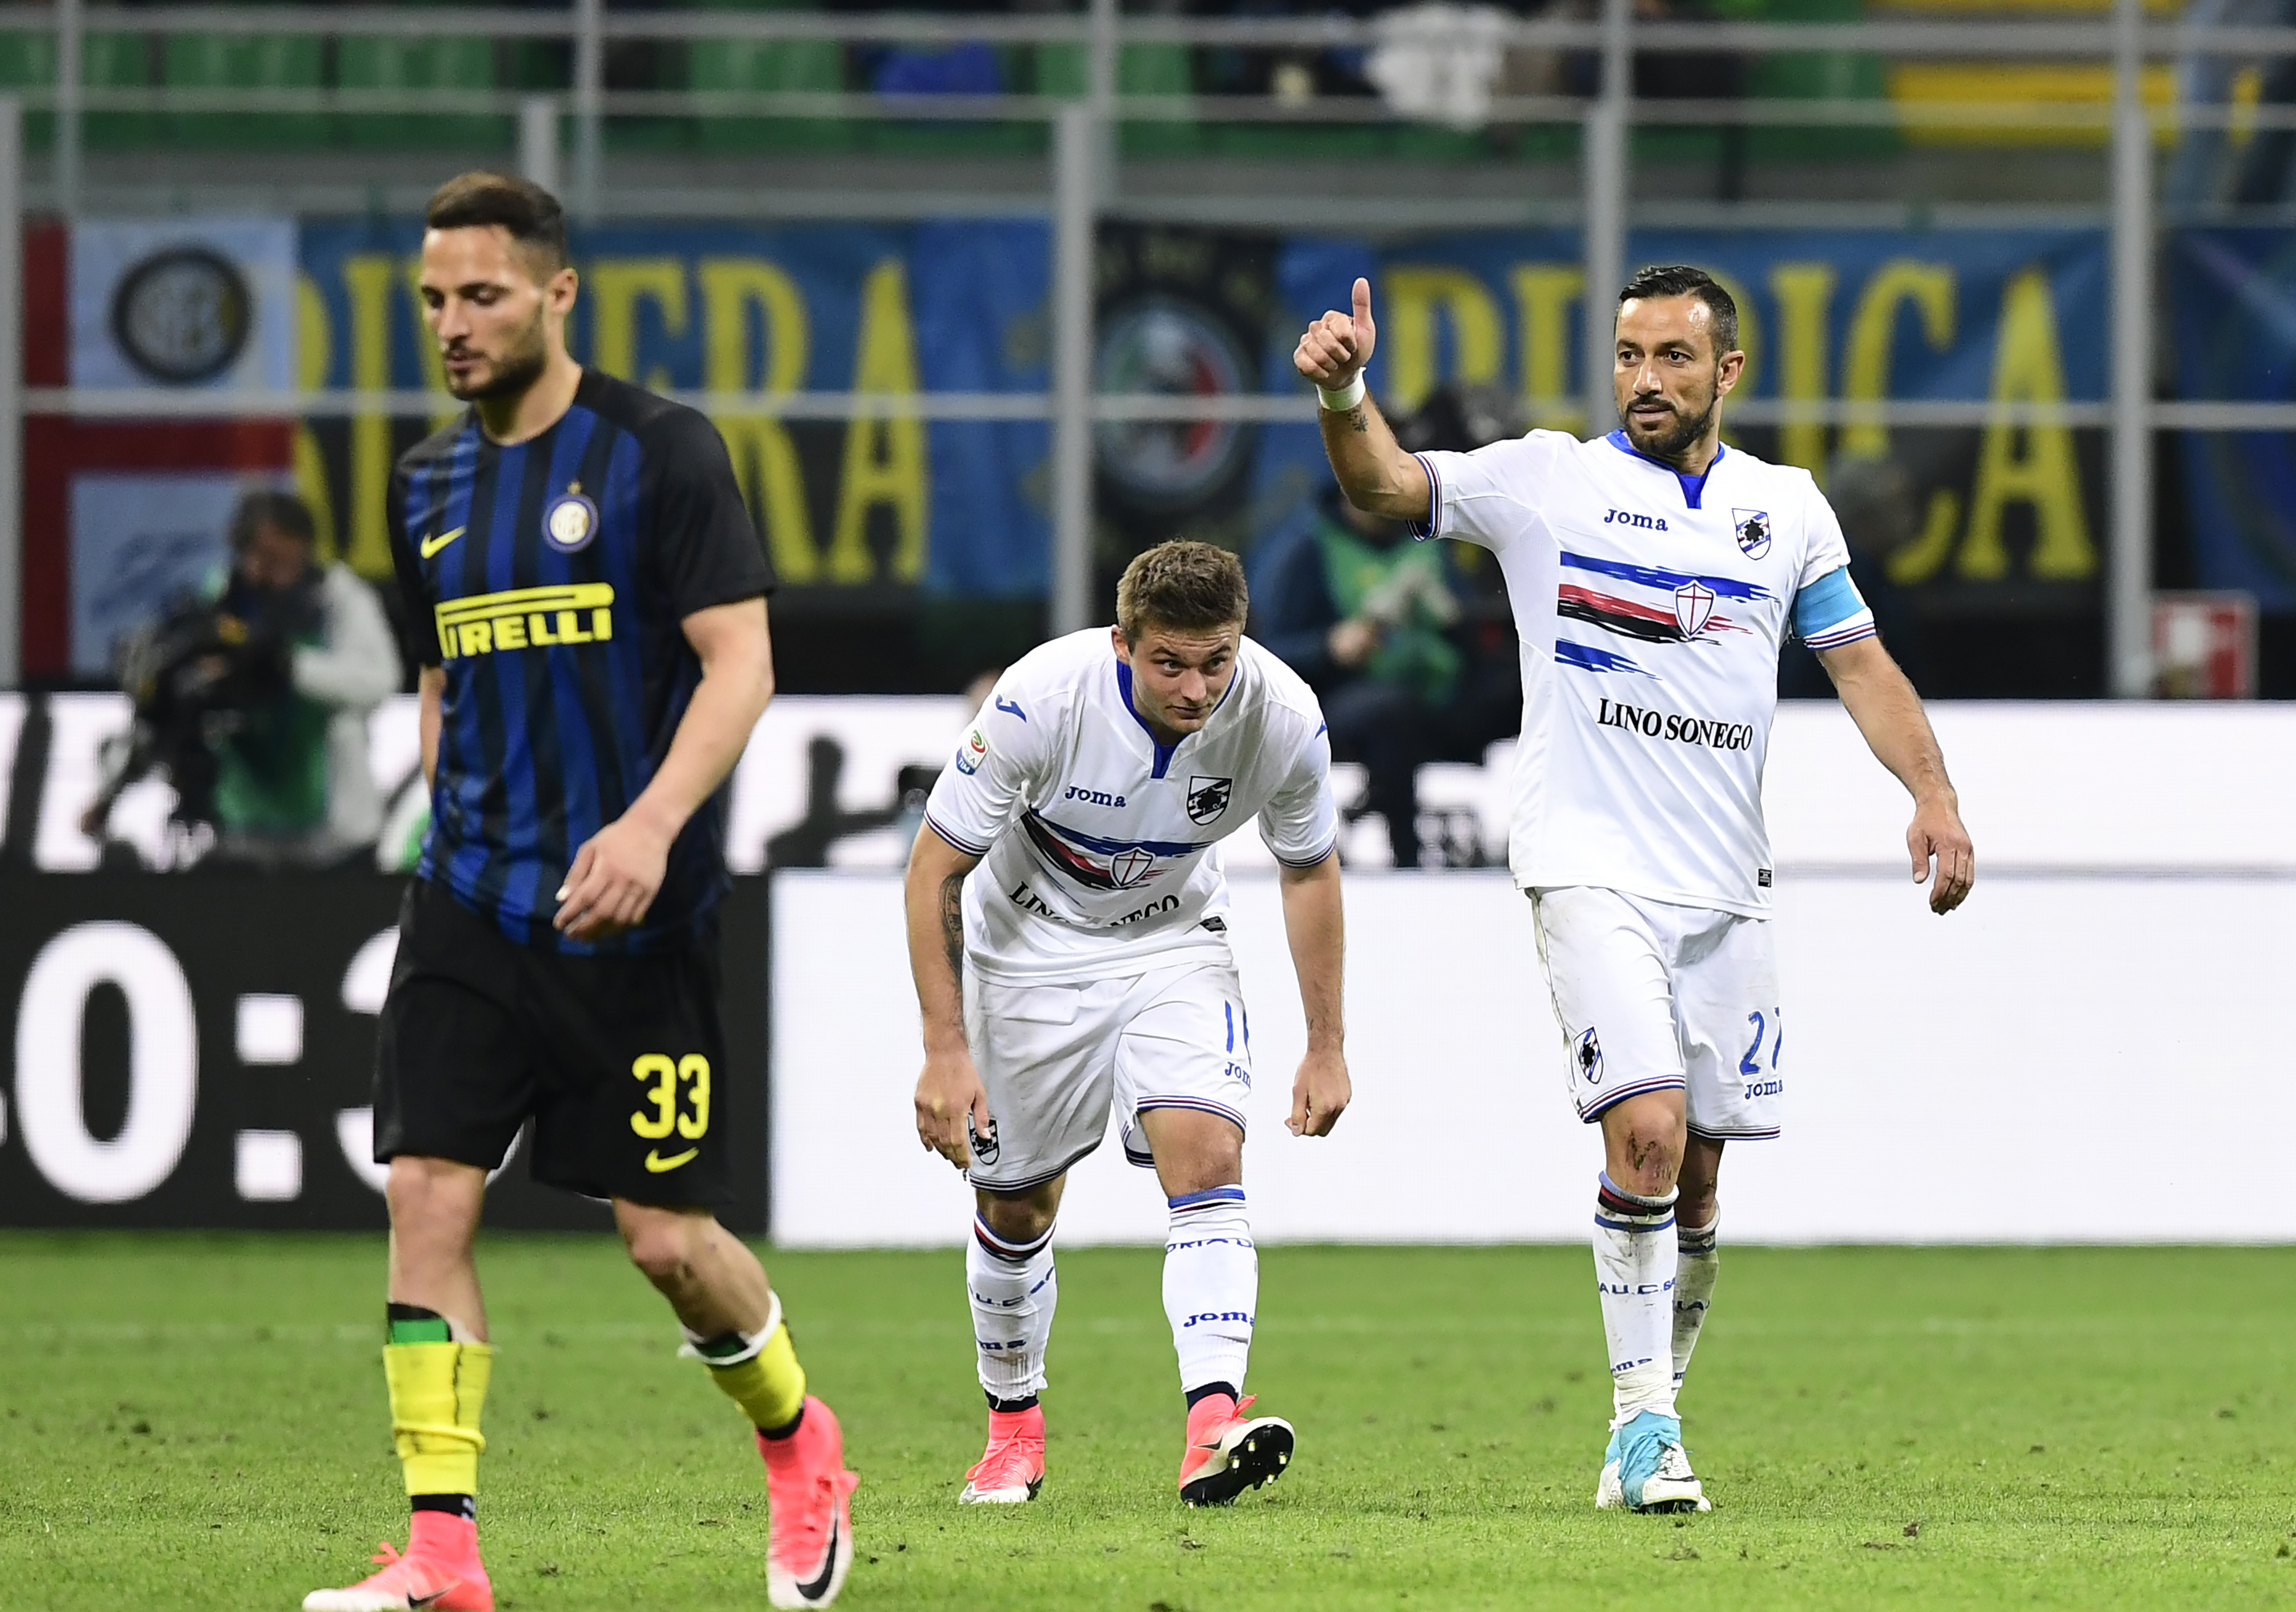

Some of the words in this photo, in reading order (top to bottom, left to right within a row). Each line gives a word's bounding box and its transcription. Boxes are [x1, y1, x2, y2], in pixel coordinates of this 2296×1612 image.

[1604, 509, 1668, 532] Joma
[434, 582, 615, 659] PIRELLI
[1597, 698, 1662, 736] LINO
[1665, 715, 1753, 751] SONEGO
[1065, 786, 1126, 807] Joma
[1009, 881, 1069, 923] LIN
[630, 1053, 710, 1139] 33
